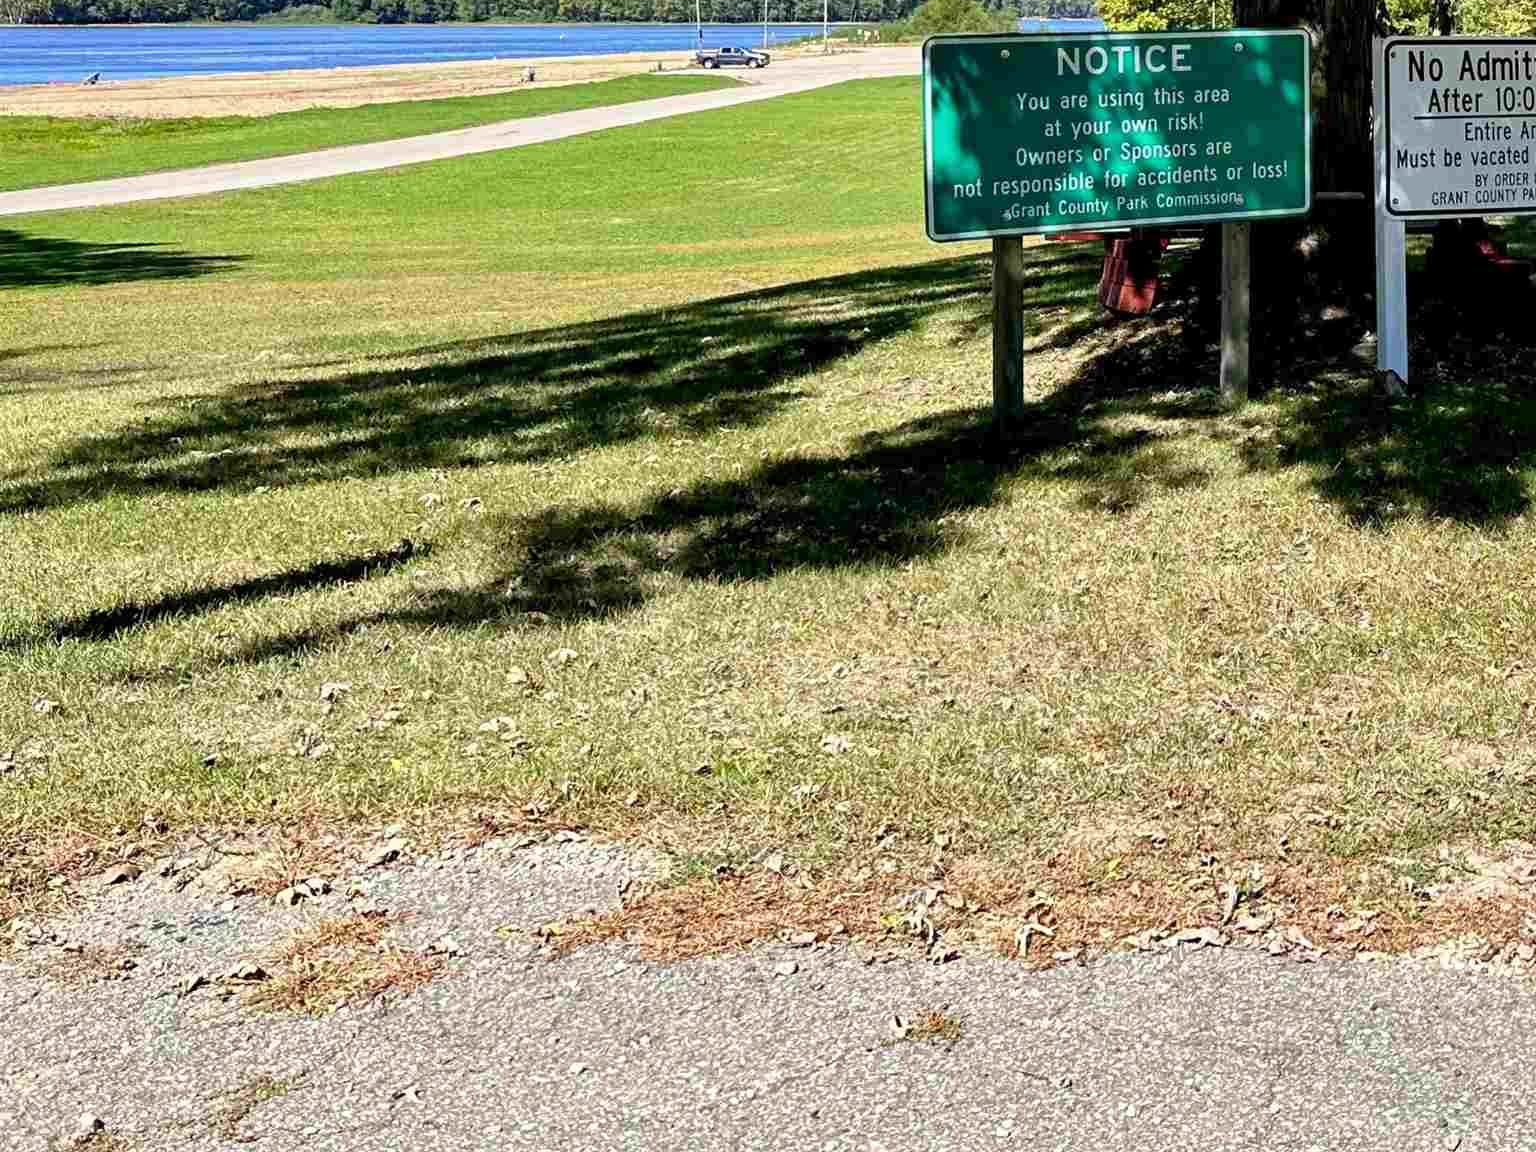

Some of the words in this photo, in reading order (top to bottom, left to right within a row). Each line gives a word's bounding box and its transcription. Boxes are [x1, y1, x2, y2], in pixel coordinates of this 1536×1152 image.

[1057, 44, 1192, 75] NOTICE
[1408, 50, 1443, 82] No
[1017, 93, 1049, 110] You
[1060, 93, 1088, 109] are
[1098, 90, 1144, 111] using
[1153, 88, 1184, 105] this
[1194, 88, 1230, 103] area
[1428, 88, 1483, 113] After
[1044, 119, 1062, 136] at
[1071, 120, 1111, 140] your
[1121, 118, 1157, 133] own
[1168, 112, 1203, 131] risk!
[1464, 122, 1512, 141] Entire
[1016, 148, 1082, 166] Owners
[1093, 148, 1111, 161] or
[1120, 143, 1197, 163] Sponsors
[1206, 141, 1232, 155] are
[1397, 149, 1435, 168] Must
[1443, 149, 1462, 167] be
[1471, 146, 1529, 166] vacated
[954, 178, 983, 197] not
[993, 171, 1094, 197] responsible
[1104, 169, 1128, 188] for
[1137, 164, 1217, 186] accidents
[1226, 165, 1243, 180] or
[1252, 160, 1288, 179] loss!
[1475, 174, 1490, 187] BY
[1494, 172, 1529, 186] ORDER
[1011, 202, 1050, 218] Grant
[1058, 196, 1108, 215] County
[1117, 195, 1149, 210] Park
[1156, 191, 1238, 208] Commission
[1431, 190, 1469, 206] GRANT
[1475, 188, 1518, 203] COUNTY
